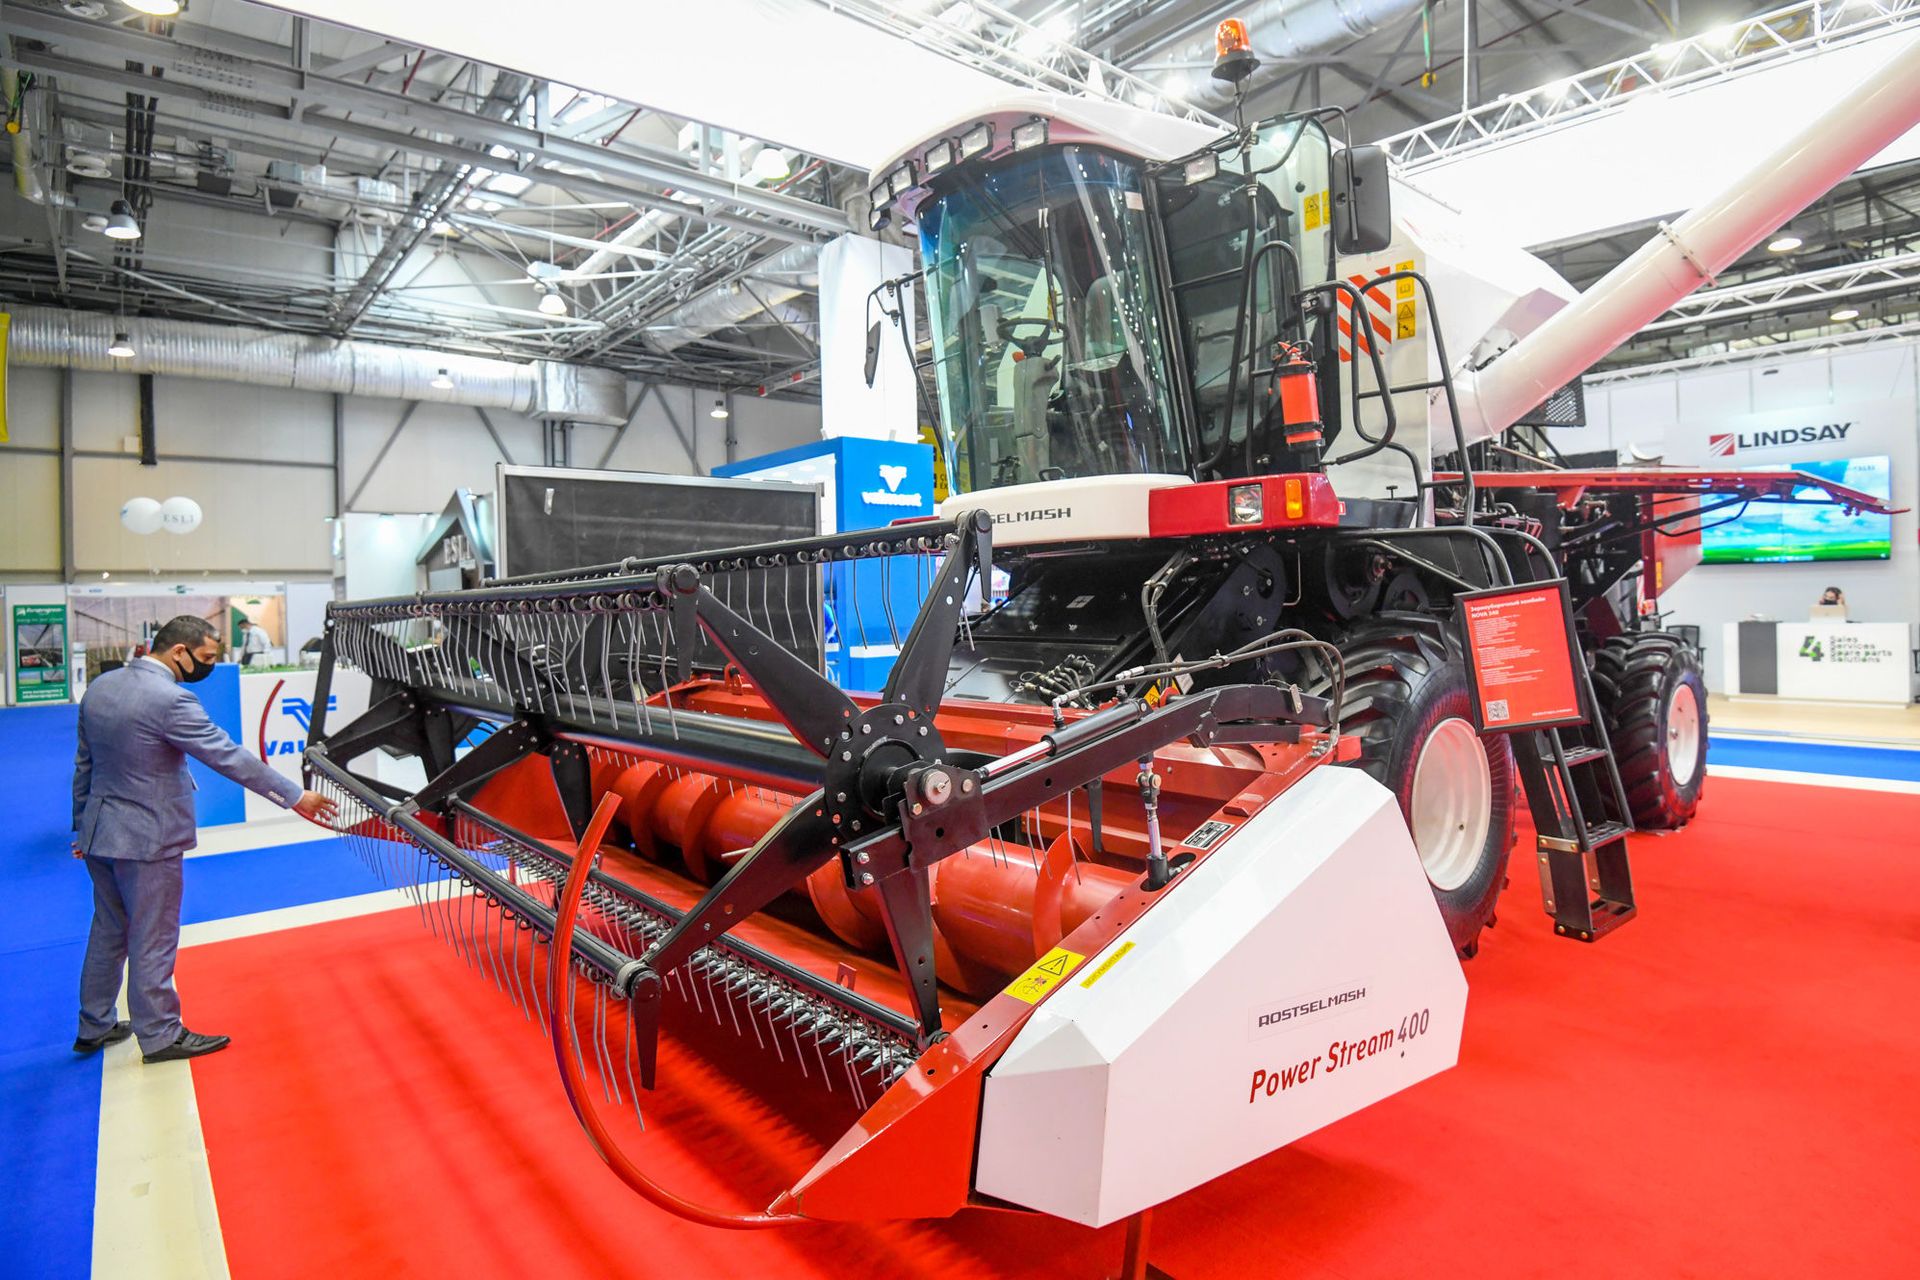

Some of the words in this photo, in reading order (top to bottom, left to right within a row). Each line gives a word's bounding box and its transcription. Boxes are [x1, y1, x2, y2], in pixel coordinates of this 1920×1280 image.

[1738, 422, 1851, 448] LINDSAY
[990, 508, 1071, 524] SELMASH
[1258, 987, 1366, 1028] ROSTSELMASH
[1249, 1055, 1321, 1104] Power
[1326, 1029, 1394, 1073] Stream
[1397, 1008, 1430, 1043] 400
